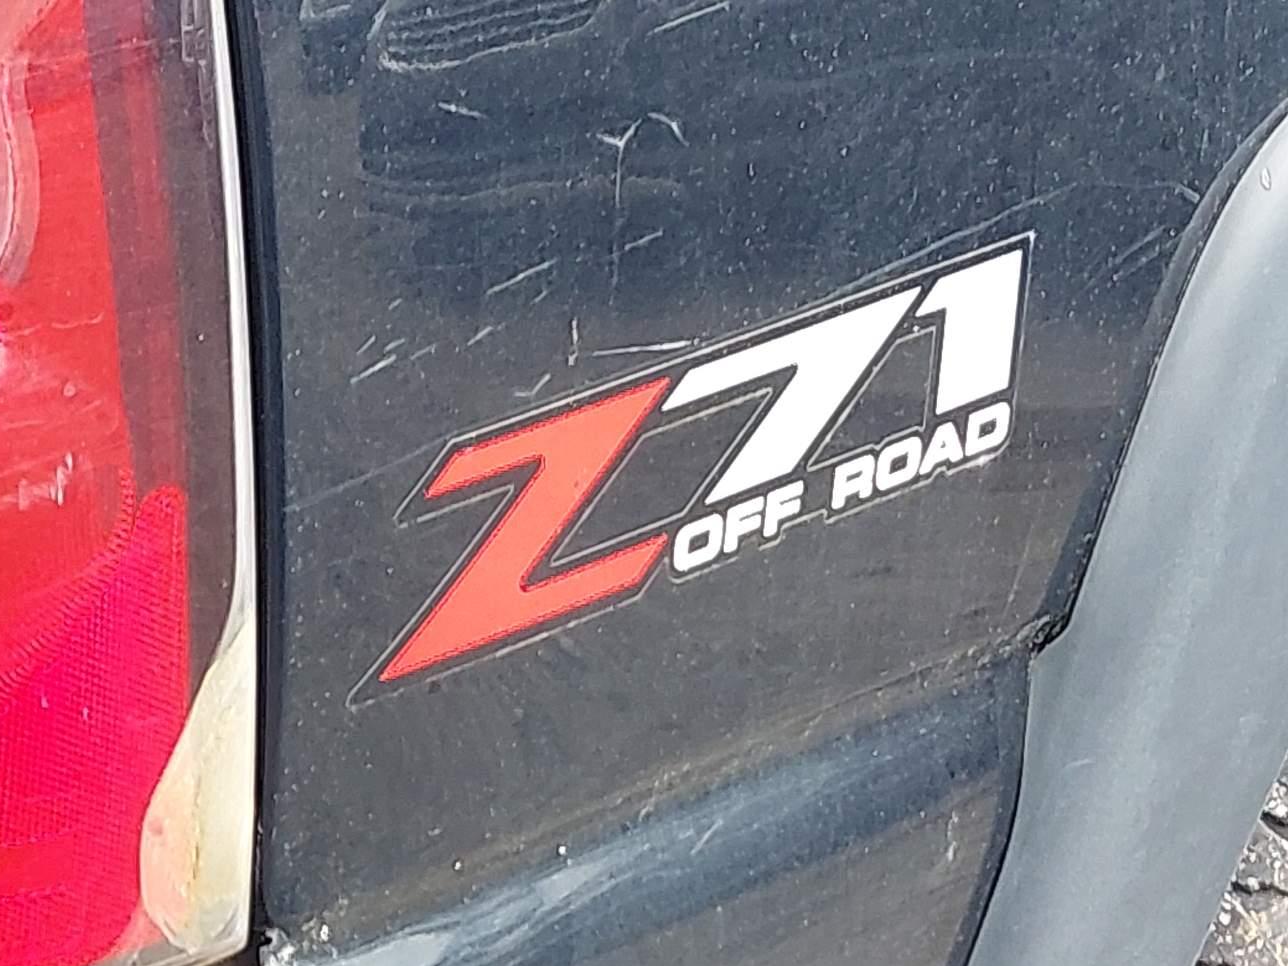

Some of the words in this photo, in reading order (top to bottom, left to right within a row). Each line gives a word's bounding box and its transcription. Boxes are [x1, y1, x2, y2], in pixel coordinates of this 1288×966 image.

[378, 248, 1024, 681] Z71
[672, 480, 805, 573] OFF
[830, 402, 1011, 510] ROAD
